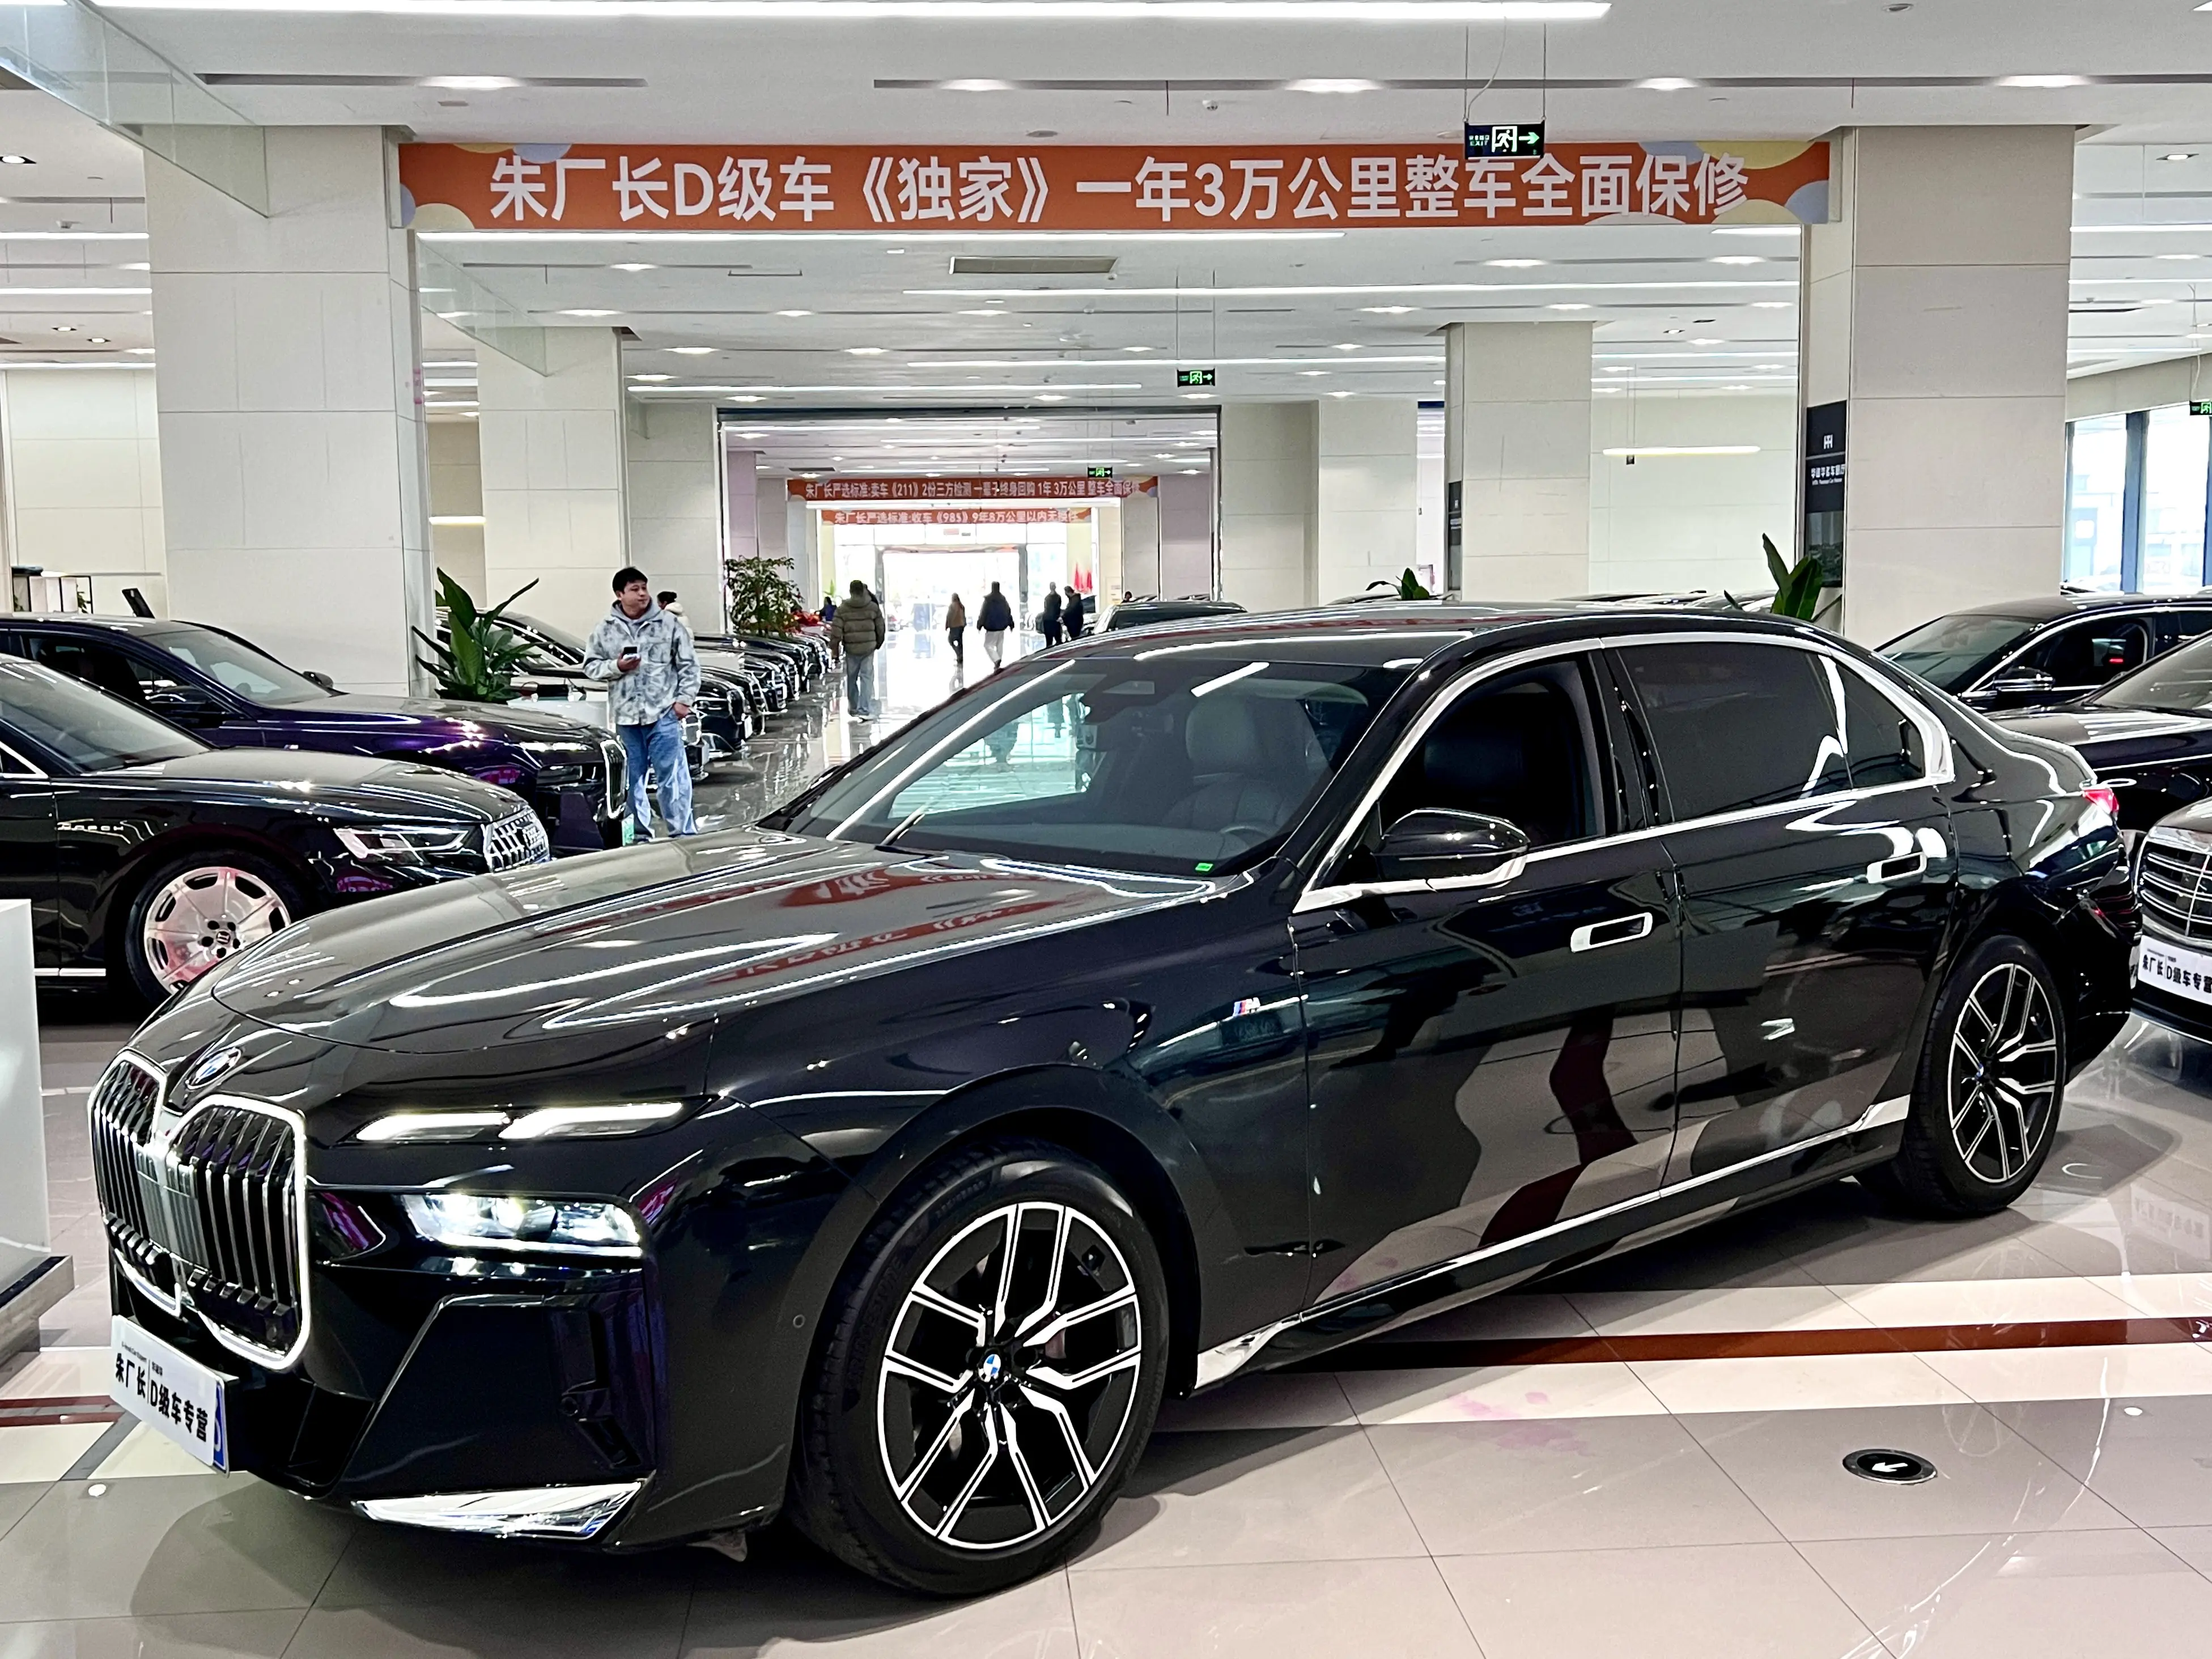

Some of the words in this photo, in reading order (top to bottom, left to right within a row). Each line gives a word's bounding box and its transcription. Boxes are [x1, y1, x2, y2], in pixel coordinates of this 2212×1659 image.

[116, 1352, 146, 1399] 朱厂长
[150, 1379, 209, 1442] D级车专营
